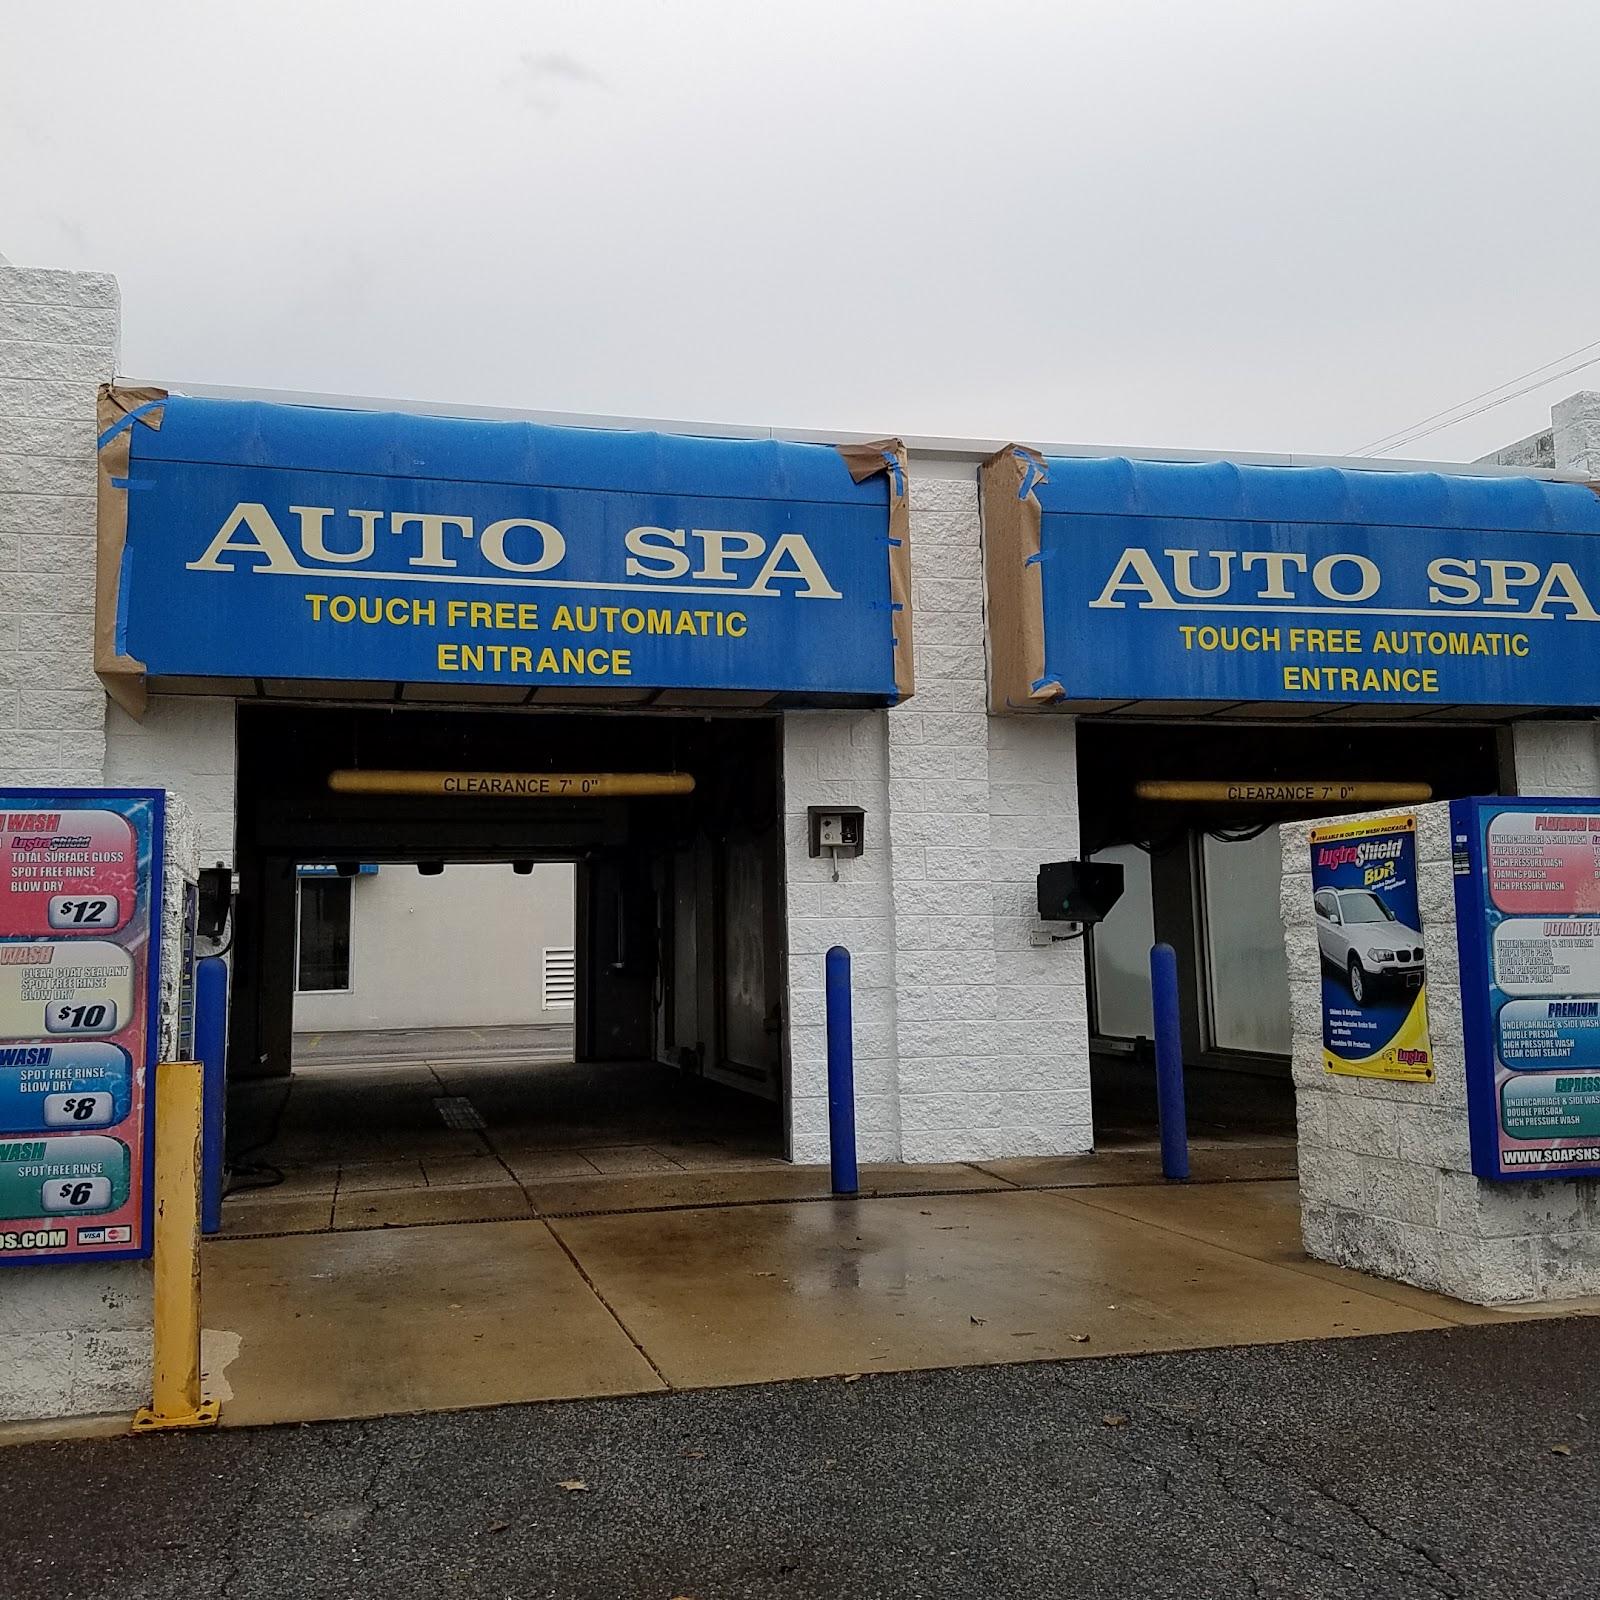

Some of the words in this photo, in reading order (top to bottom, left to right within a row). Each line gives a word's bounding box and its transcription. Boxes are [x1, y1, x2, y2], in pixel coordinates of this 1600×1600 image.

[185, 502, 566, 573] AUTO
[624, 526, 843, 599] SPA
[1088, 547, 1381, 609] AUTO
[1427, 557, 1600, 621] SPA
[305, 593, 435, 626] TOUCH
[448, 600, 538, 630] FREE
[552, 605, 748, 638] AUTOMATIC
[1179, 625, 1281, 652] TOUCH
[1289, 628, 1362, 653] FREE
[1373, 630, 1530, 657] AUTOMATIC
[437, 643, 632, 675] ENTRANCE
[1283, 666, 1439, 693] ENTRANCE
[443, 777, 550, 794] CLEARANCE
[559, 779, 573, 793] 7'
[581, 779, 599, 794] 0"
[1228, 786, 1314, 800] CLEARANCE
[1321, 787, 1333, 799] 7'
[7, 813, 61, 832] WASH
[12, 851, 42, 863] TOTAL
[44, 851, 89, 863] SURFACE
[91, 851, 124, 862] GLOSS
[11, 867, 37, 877] SPOT
[40, 866, 64, 877] FREE
[65, 866, 96, 877] RINSE
[11, 881, 41, 892] BLOW
[43, 880, 64, 891] DRY
[60, 901, 107, 923] $12
[1543, 921, 1592, 937] ULTIMATE
[22, 968, 54, 978] CLEAR
[56, 967, 82, 978] COAT
[83, 966, 129, 977] SEALANT
[21, 979, 48, 989] SPOT
[50, 978, 74, 989] FREE
[75, 978, 107, 988] RINSE
[58, 1005, 106, 1028] $10
[1548, 1002, 1599, 1018] PREMIUM
[1502, 1031, 1528, 1039] DOUBLE
[1503, 1040, 1520, 1049] HIGH
[1520, 1040, 1554, 1048] PRESSURE
[1554, 1039, 1575, 1048] WASH
[0, 1047, 53, 1067] WASH
[1503, 1050, 1524, 1058] CLEAR
[1524, 1050, 1542, 1058] COAT
[1542, 1049, 1571, 1057] SEALANT
[20, 1069, 47, 1080] SPOT
[50, 1069, 74, 1079] FREE
[75, 1068, 105, 1078] RINSE
[20, 1082, 50, 1093] BLOW
[52, 1081, 73, 1092] DRY
[63, 1097, 97, 1121] $8
[1506, 1108, 1532, 1117] DOUBLE
[1533, 1107, 1563, 1116] PRESOAK
[1507, 1118, 1524, 1127] HIGH
[1525, 1117, 1560, 1126] PRESSURE
[1560, 1116, 1580, 1125] WASH
[18, 1166, 45, 1177] SPOT
[47, 1165, 70, 1175] FREE
[72, 1163, 103, 1174] RINSE
[59, 1182, 93, 1206] $6
